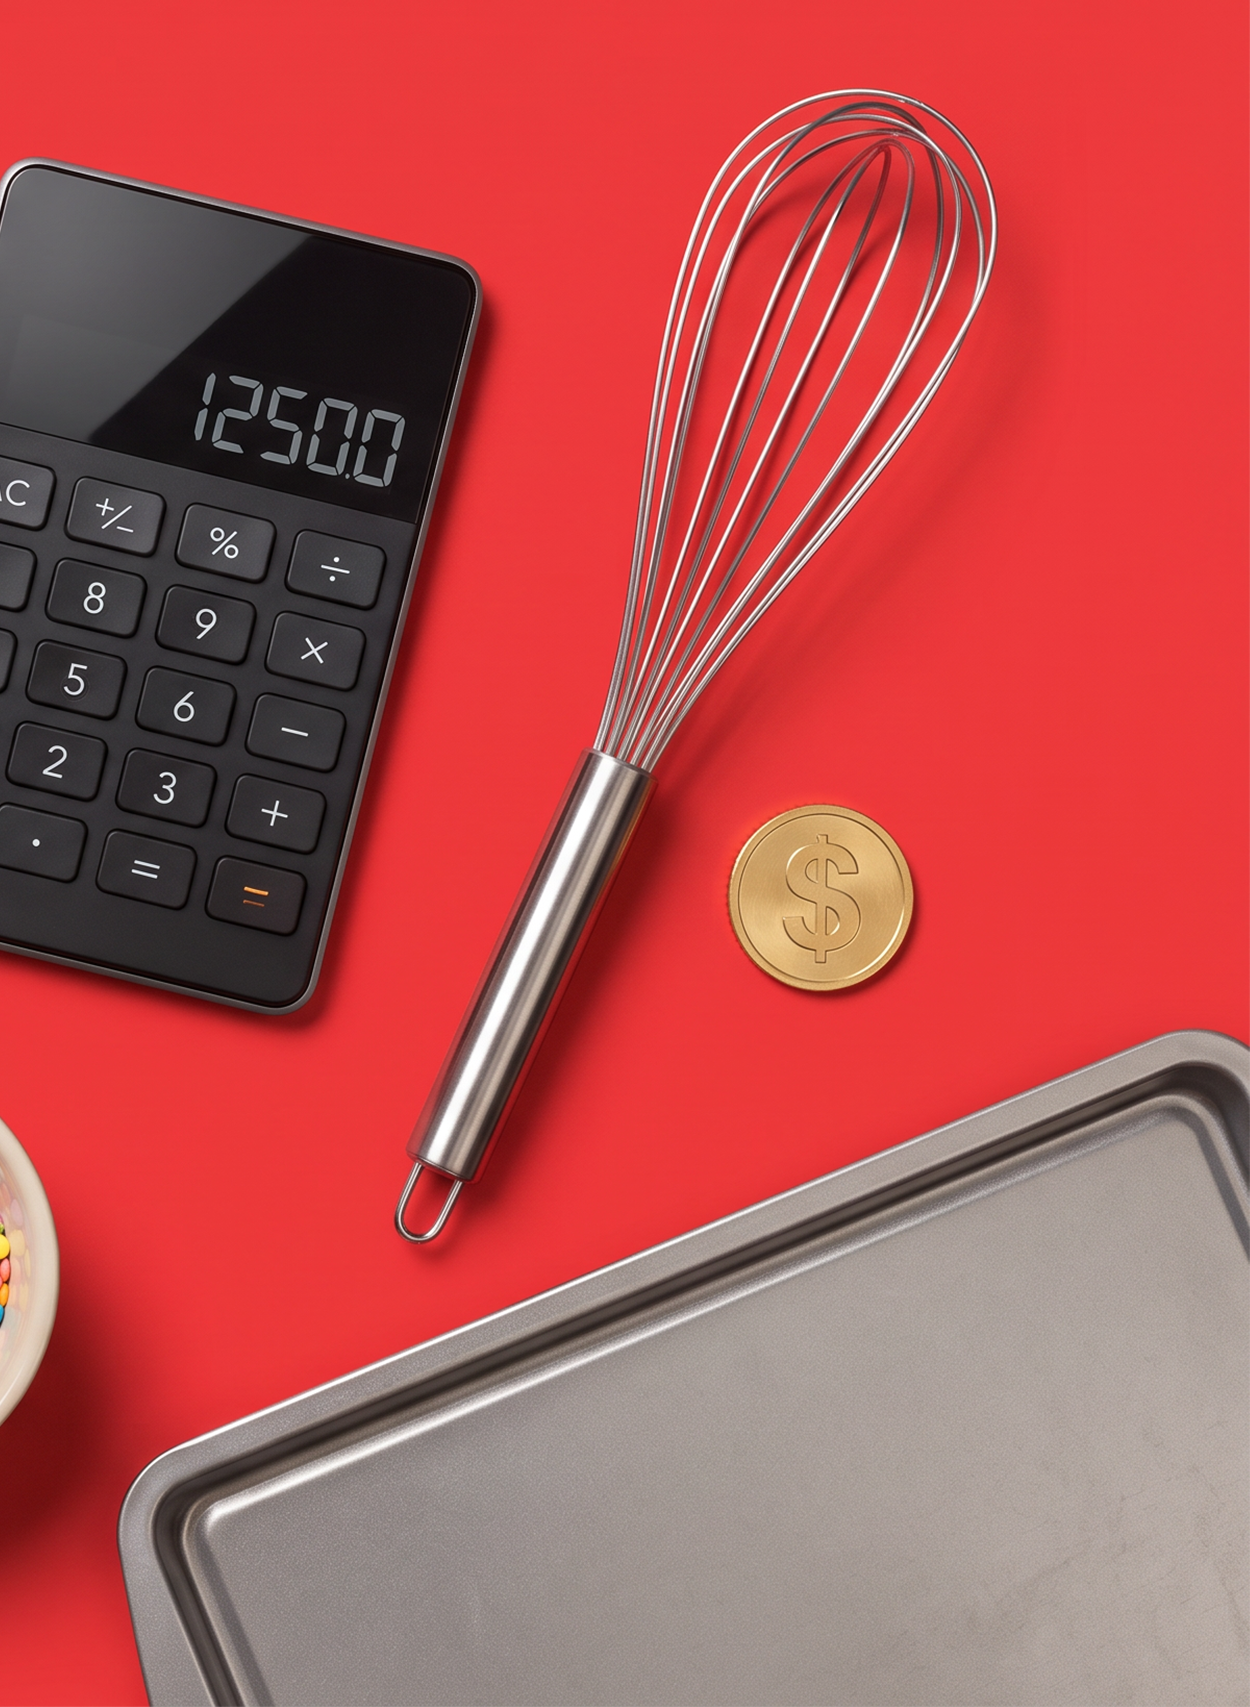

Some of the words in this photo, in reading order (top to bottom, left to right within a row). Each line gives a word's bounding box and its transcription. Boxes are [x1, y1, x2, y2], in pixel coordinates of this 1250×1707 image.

[194, 372, 406, 487] 1250.0
[209, 526, 240, 560] %
[83, 581, 107, 615] 8
[195, 608, 217, 640] 9
[63, 662, 88, 696] 5
[173, 690, 195, 723] 6
[42, 745, 68, 779] 2
[153, 771, 177, 805] 3
[783, 834, 861, 964] $
